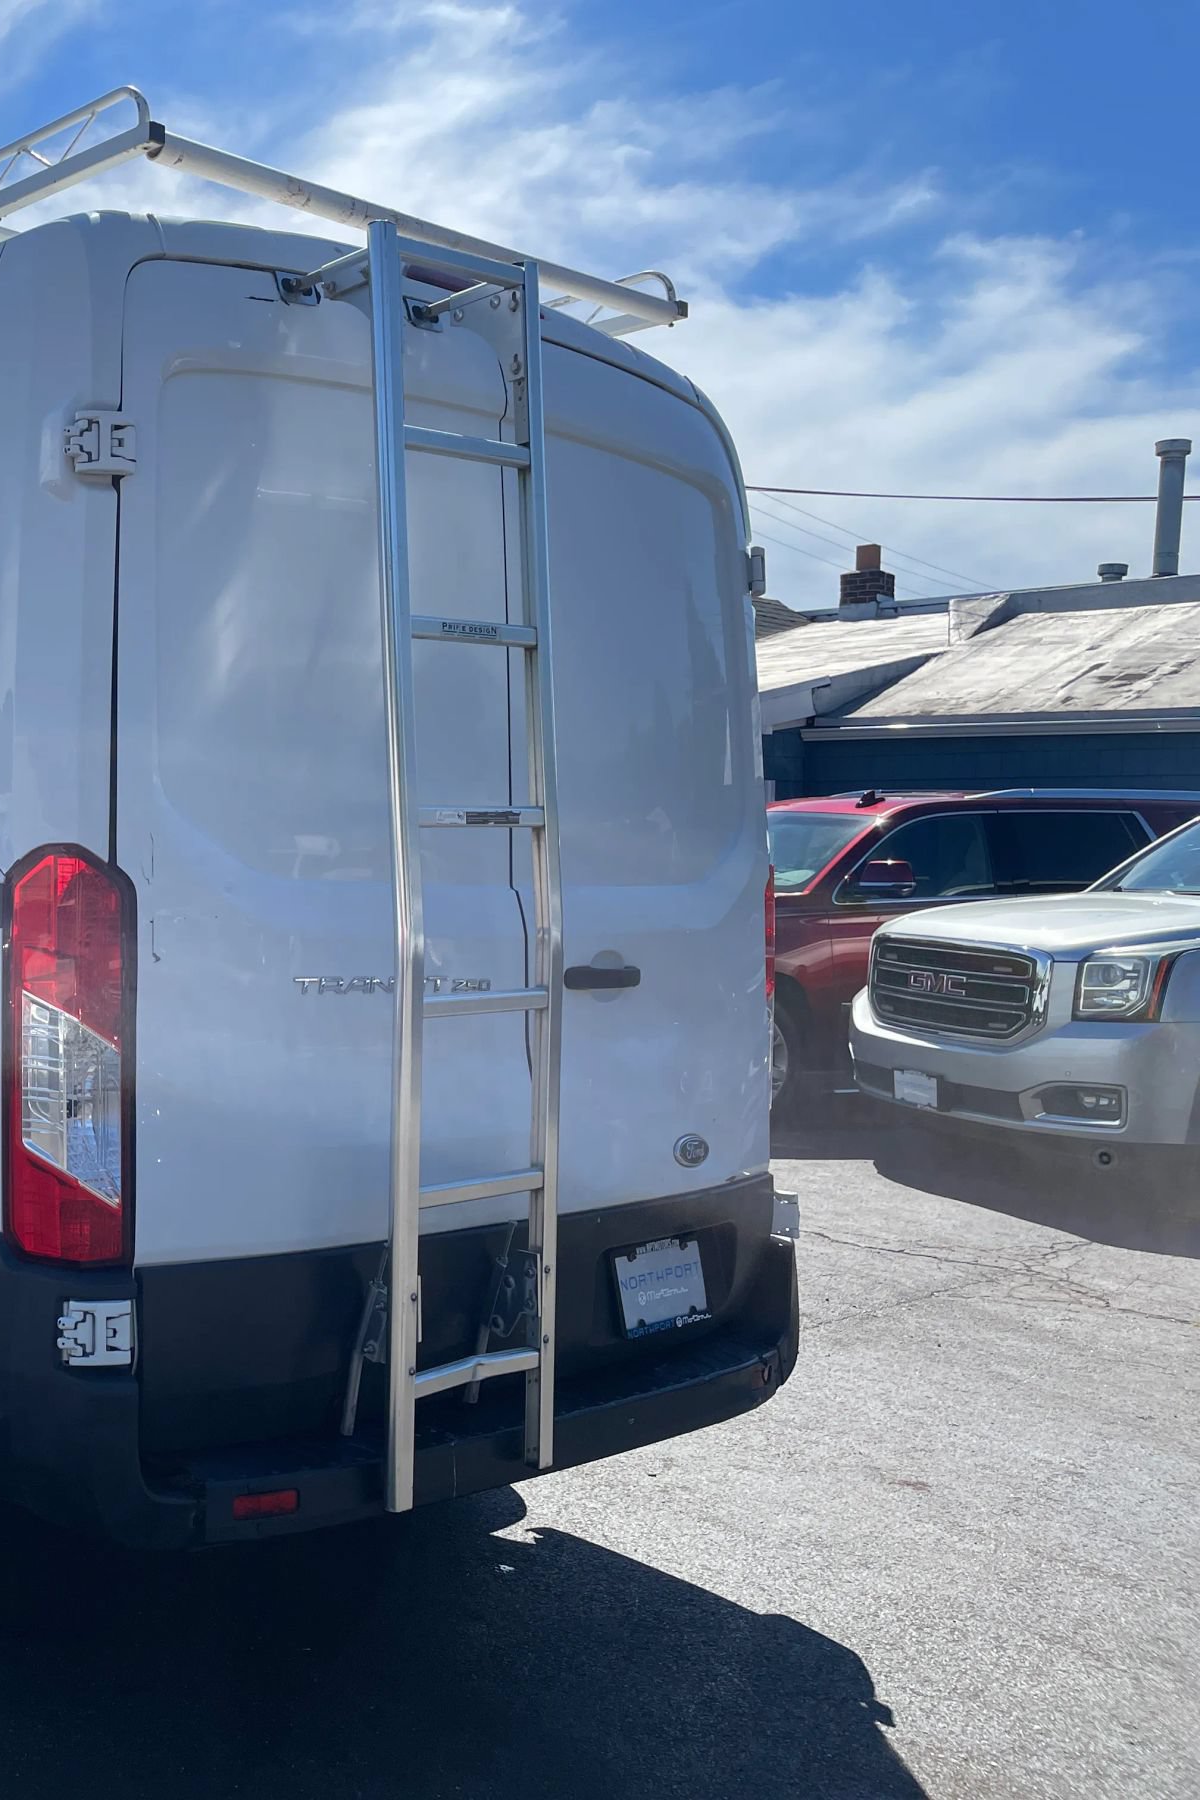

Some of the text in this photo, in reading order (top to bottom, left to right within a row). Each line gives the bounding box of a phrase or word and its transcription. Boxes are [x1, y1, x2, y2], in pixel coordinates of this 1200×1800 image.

[468, 625, 497, 635] DESIGN
[294, 976, 491, 994] TRANT 250
[907, 970, 967, 996] GMC
[620, 1261, 699, 1292] NORTHPORT
[627, 1319, 676, 1340] NORTHPORT
